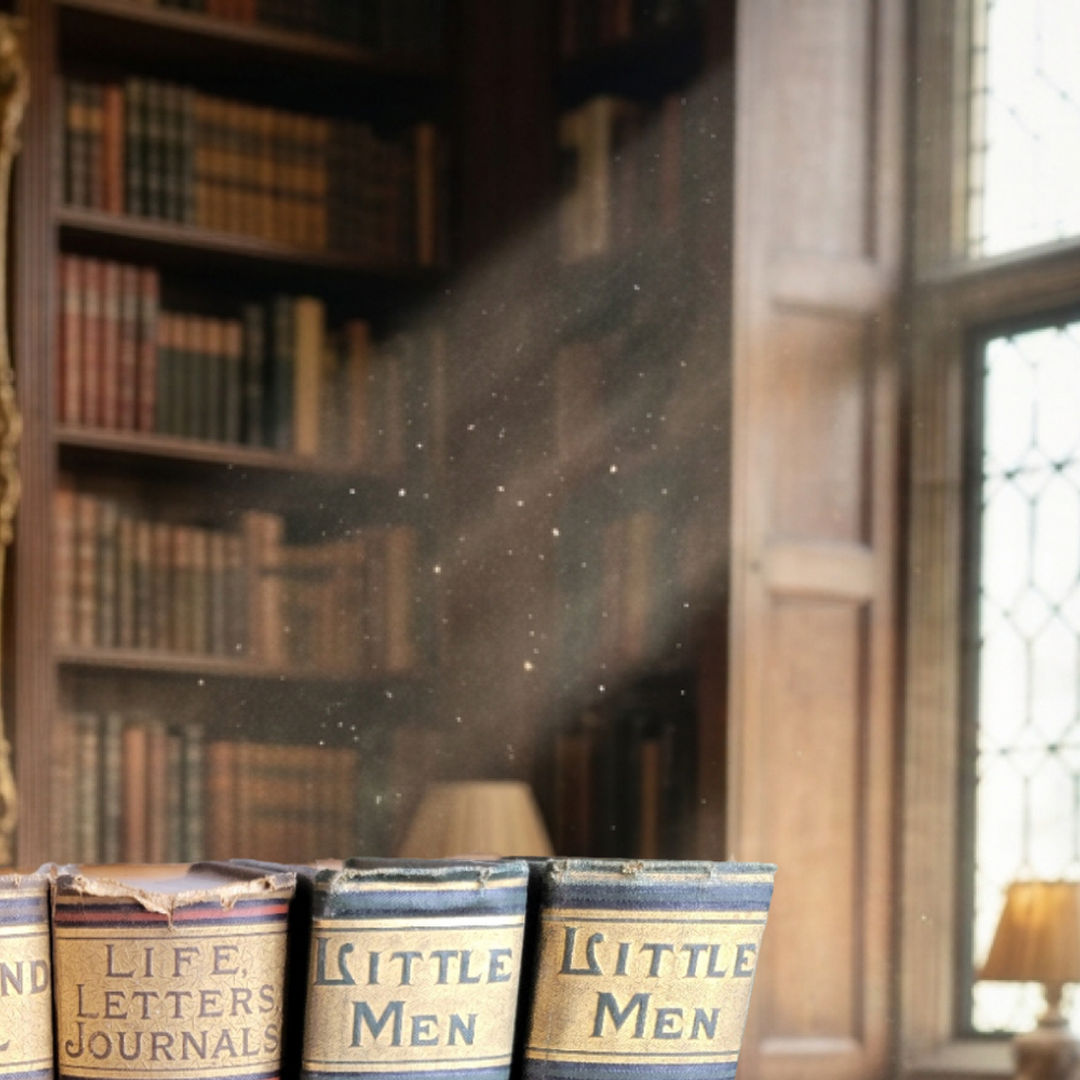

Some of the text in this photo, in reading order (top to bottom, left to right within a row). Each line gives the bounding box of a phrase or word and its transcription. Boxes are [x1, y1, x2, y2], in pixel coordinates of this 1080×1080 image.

[105, 943, 248, 979] LIFE,
[313, 937, 513, 986] LITTLE
[559, 926, 757, 979] LITTLE
[350, 1000, 477, 1048] MEN
[590, 991, 721, 1041] MEN
[65, 1021, 280, 1062] JOURNALS
